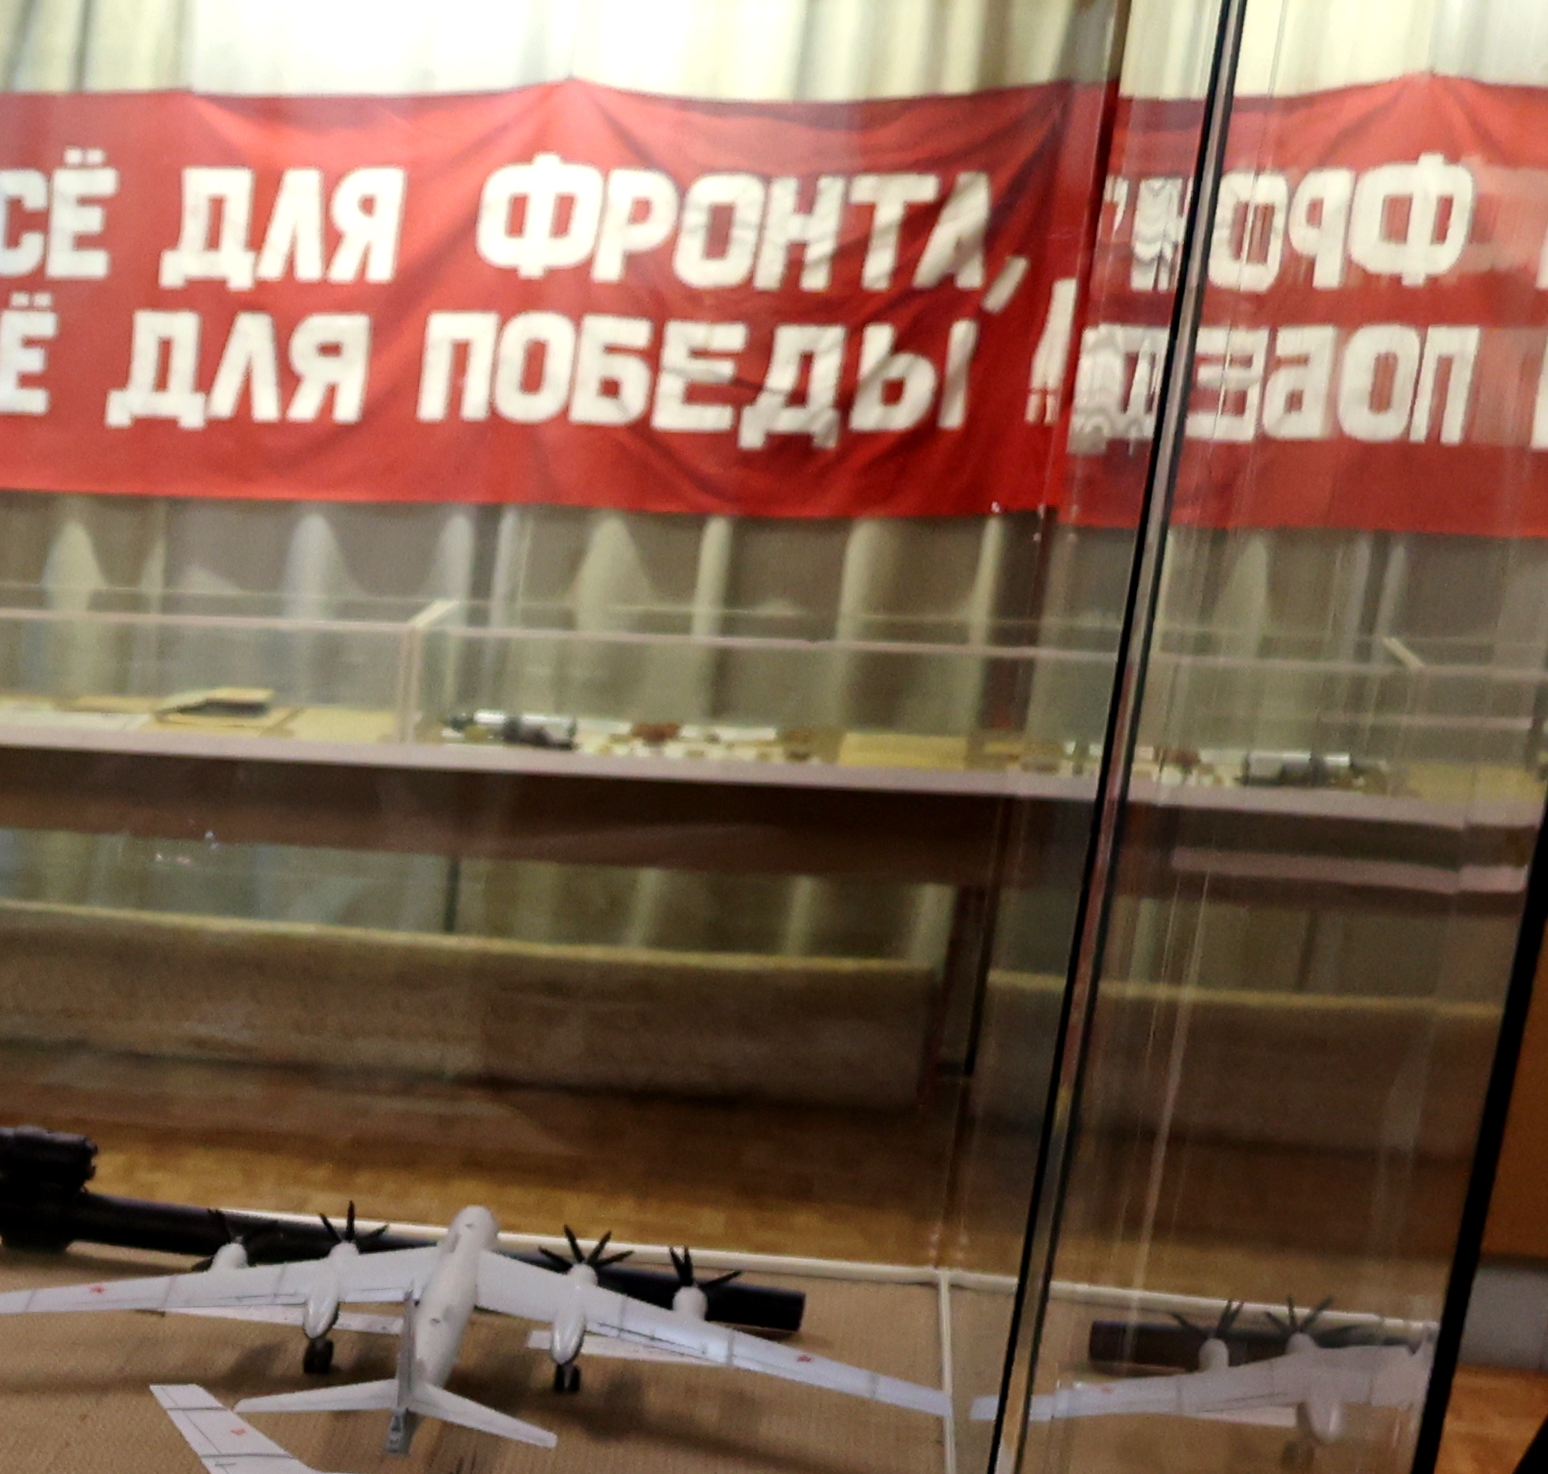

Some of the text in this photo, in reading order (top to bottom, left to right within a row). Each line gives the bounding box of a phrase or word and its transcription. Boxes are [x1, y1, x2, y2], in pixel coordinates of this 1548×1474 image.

[158, 166, 406, 290] ДЛЯ
[475, 151, 1030, 313] ФРОНТА,
[105, 310, 370, 430] ДЛЯ
